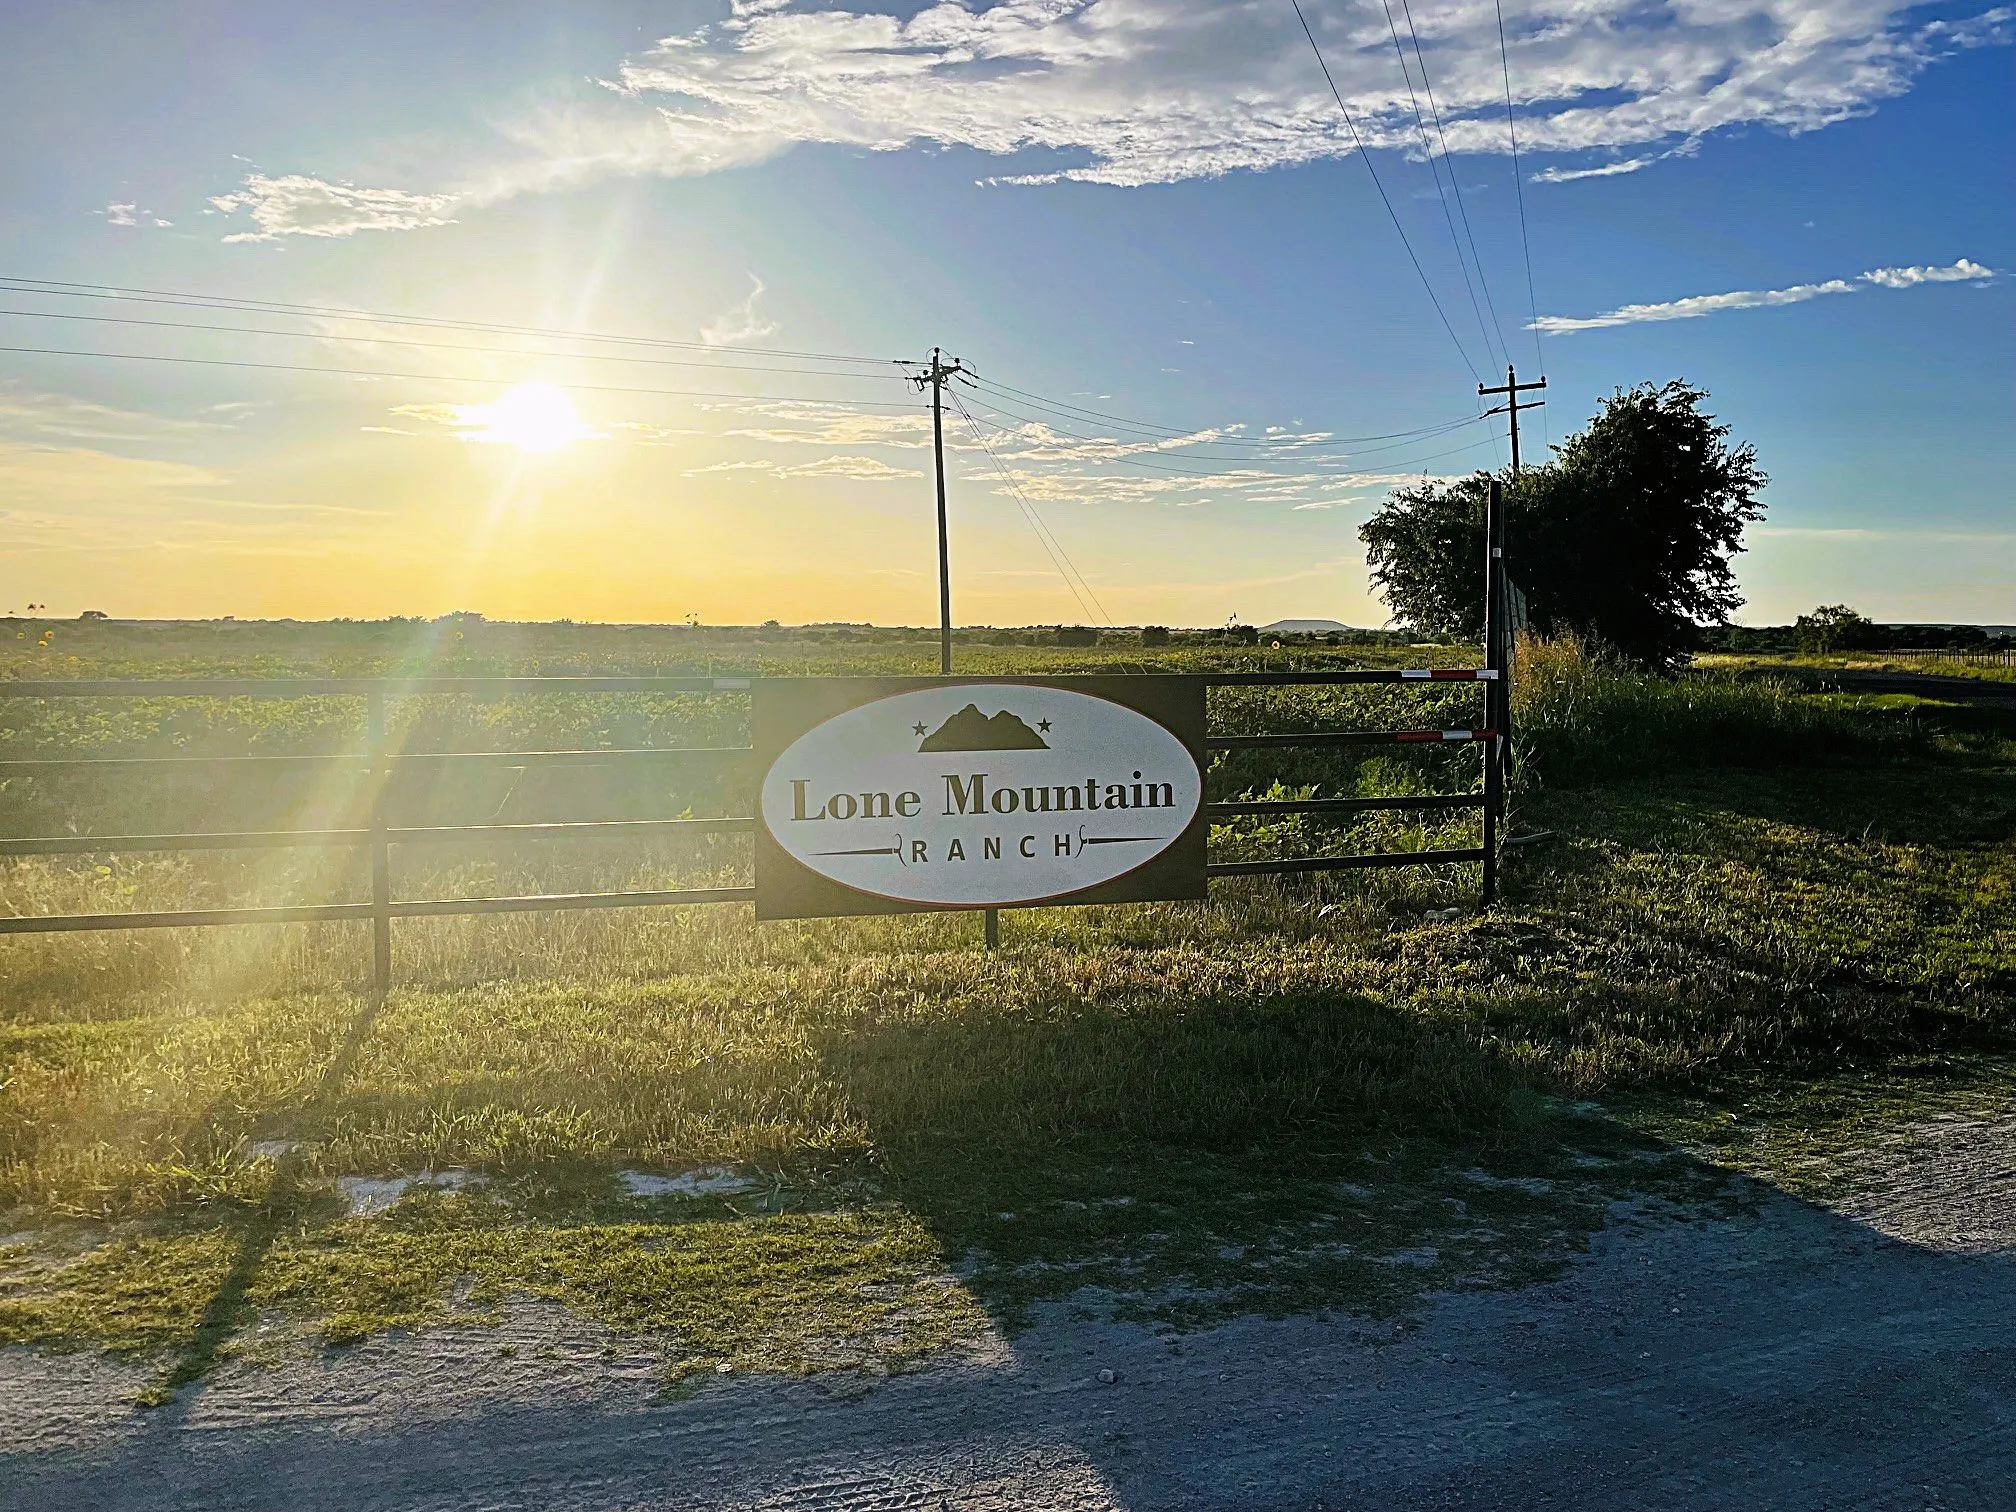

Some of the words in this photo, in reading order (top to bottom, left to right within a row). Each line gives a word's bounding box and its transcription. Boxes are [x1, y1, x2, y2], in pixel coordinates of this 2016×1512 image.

[789, 779, 922, 822] Lone
[940, 770, 1177, 817] Mountain
[911, 834, 1072, 863] RANCH
